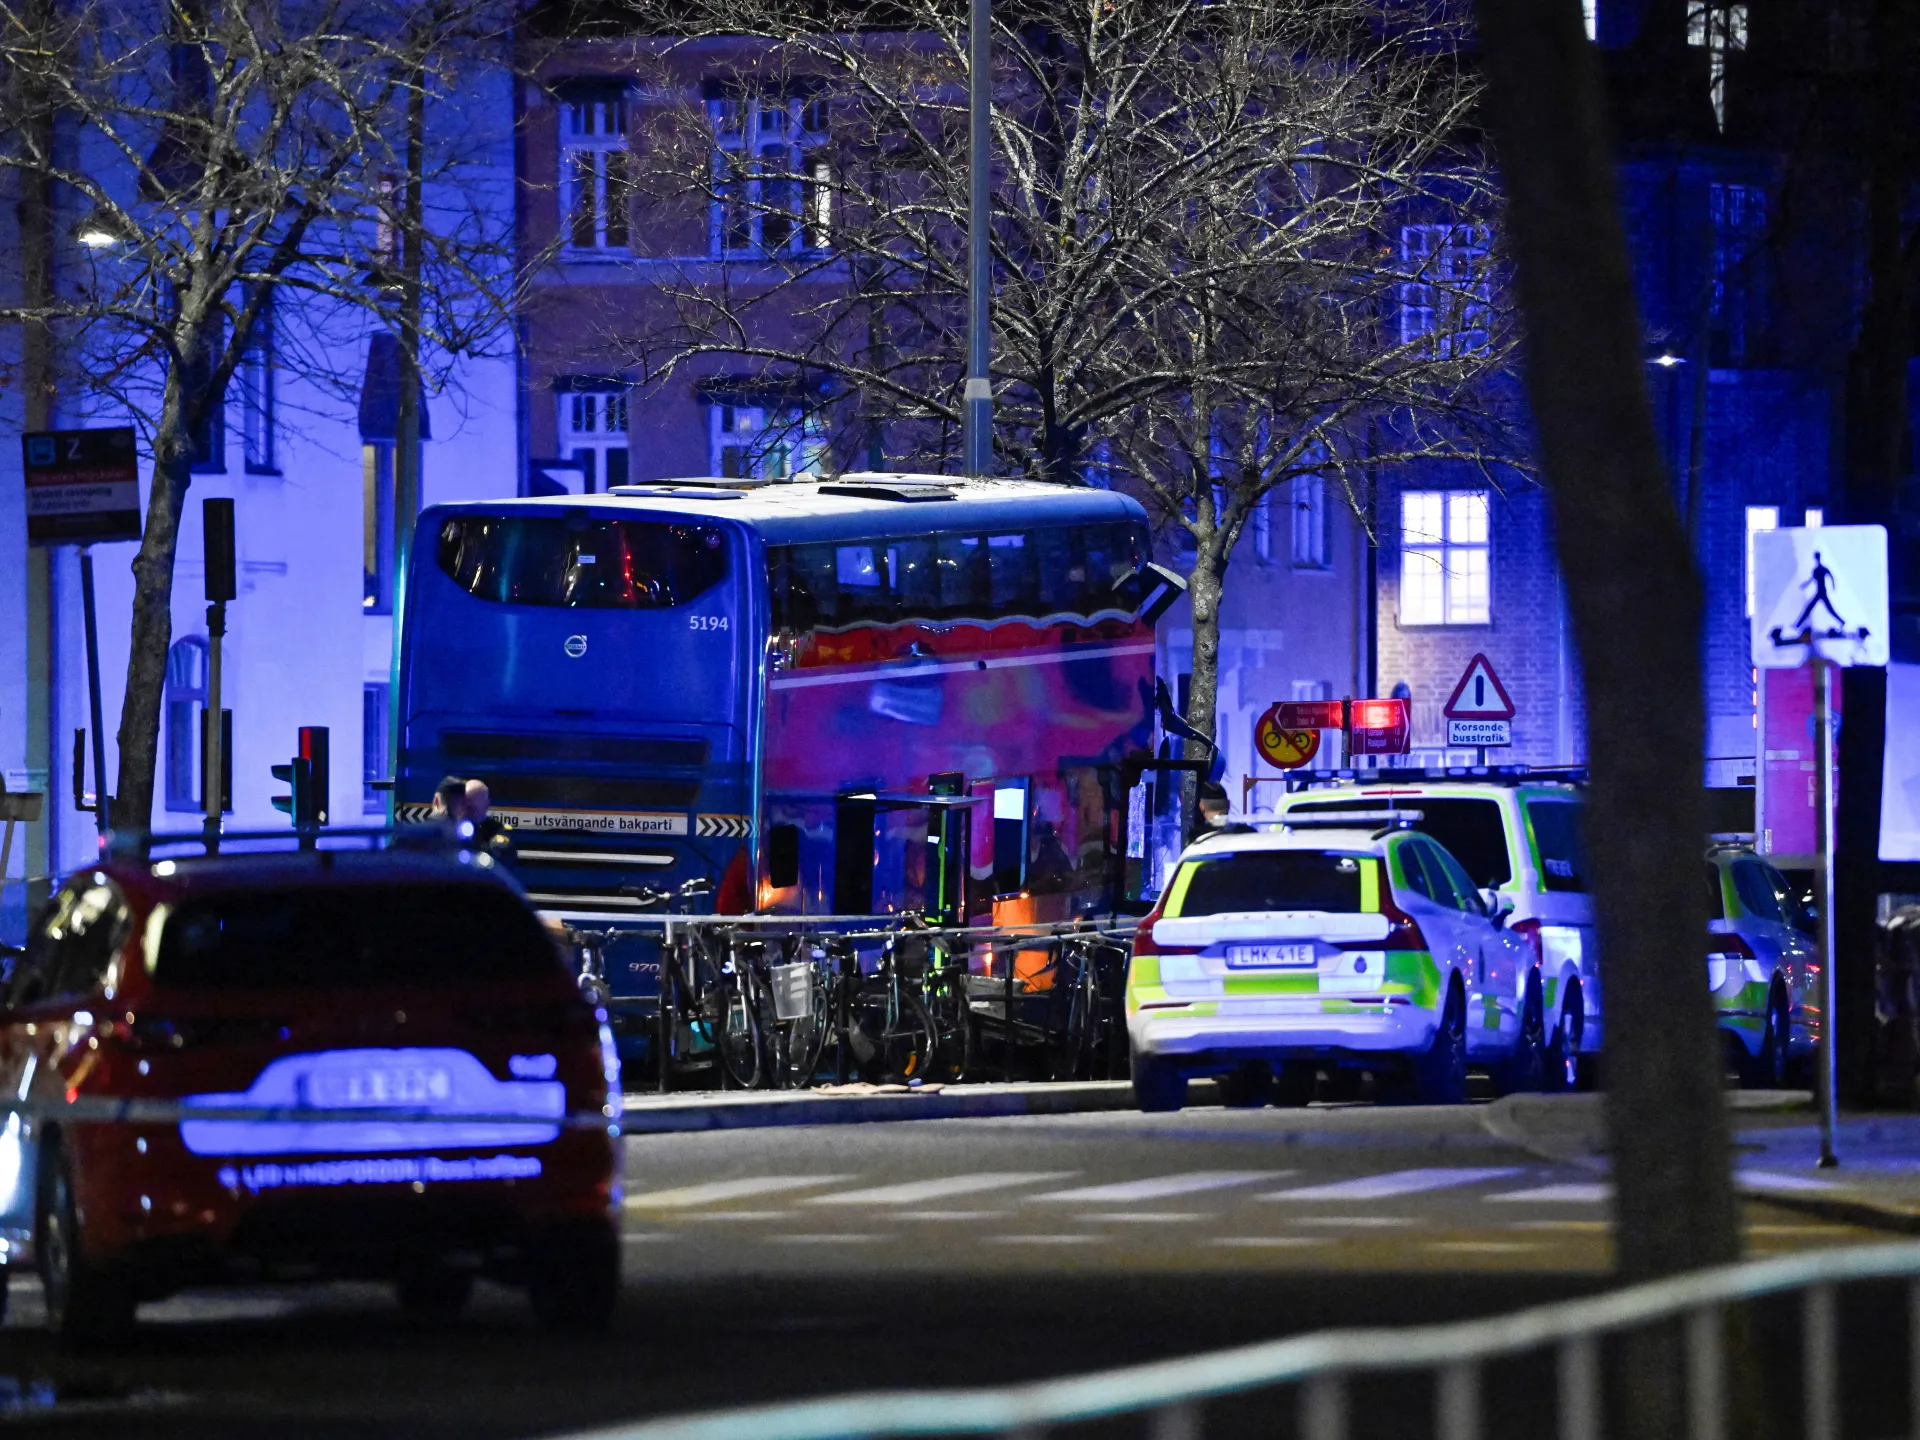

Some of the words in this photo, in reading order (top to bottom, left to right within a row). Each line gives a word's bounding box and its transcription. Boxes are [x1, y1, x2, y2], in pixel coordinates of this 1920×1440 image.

[689, 615, 729, 631] 5194
[1454, 722, 1504, 732] Korsande
[1452, 733, 1505, 742] busstrafik
[534, 815, 615, 830] utsvängande
[619, 817, 673, 832] bakparti
[1240, 946, 1270, 963] LMK
[1275, 945, 1306, 962] 41E
[628, 962, 661, 972] 970
